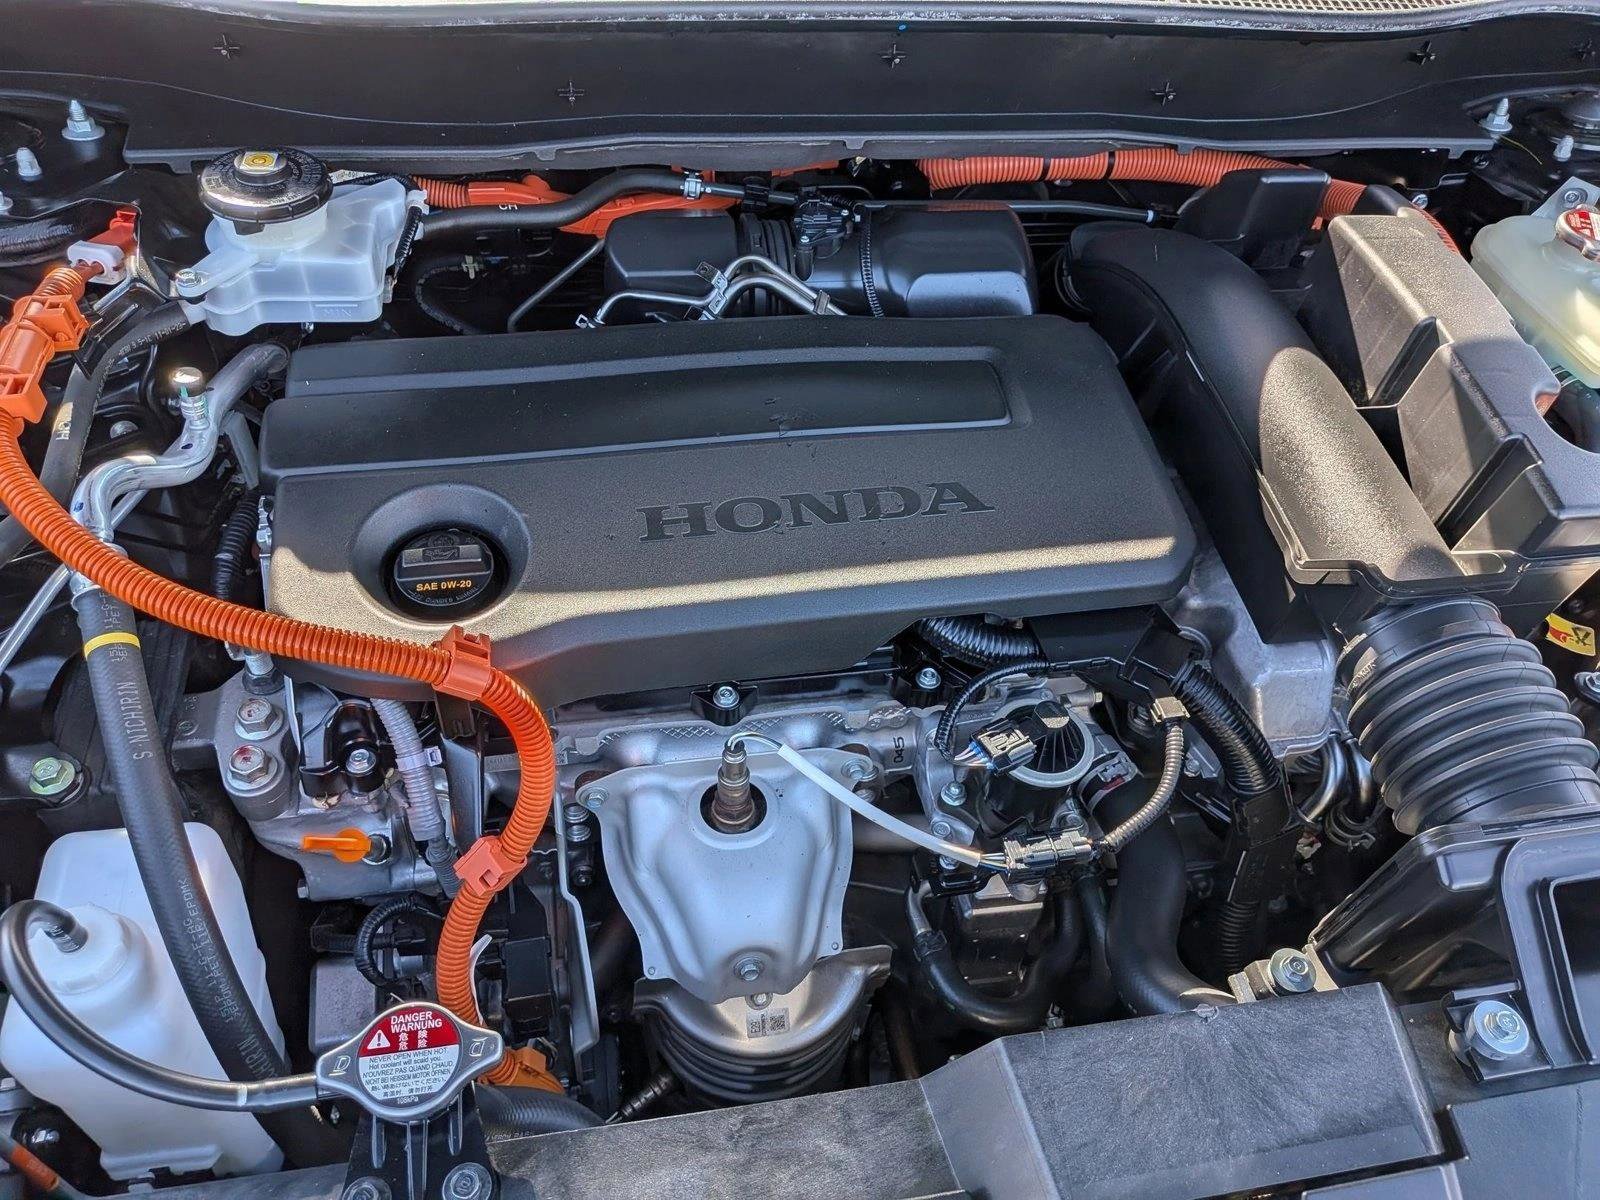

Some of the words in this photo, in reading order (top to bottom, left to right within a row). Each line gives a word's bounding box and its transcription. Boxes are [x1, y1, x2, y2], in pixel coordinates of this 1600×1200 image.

[635, 481, 996, 543] HONDA
[416, 581, 438, 592] SAE
[440, 579, 472, 590] 0W-20
[893, 736, 905, 763] 045
[390, 1011, 432, 1025] DANGER
[390, 1018, 443, 1034] WARNUNG
[368, 1062, 379, 1070] Hot
[380, 1060, 402, 1069] coolant
[403, 1058, 412, 1066] will
[413, 1056, 429, 1064] scald
[369, 1054, 392, 1063] NEVER
[393, 1052, 411, 1061] OPEN
[412, 1050, 433, 1058] WHEN
[394, 1067, 407, 1075] PAS
[408, 1063, 430, 1073] QUAND
[412, 1071, 430, 1080] MOTOR
